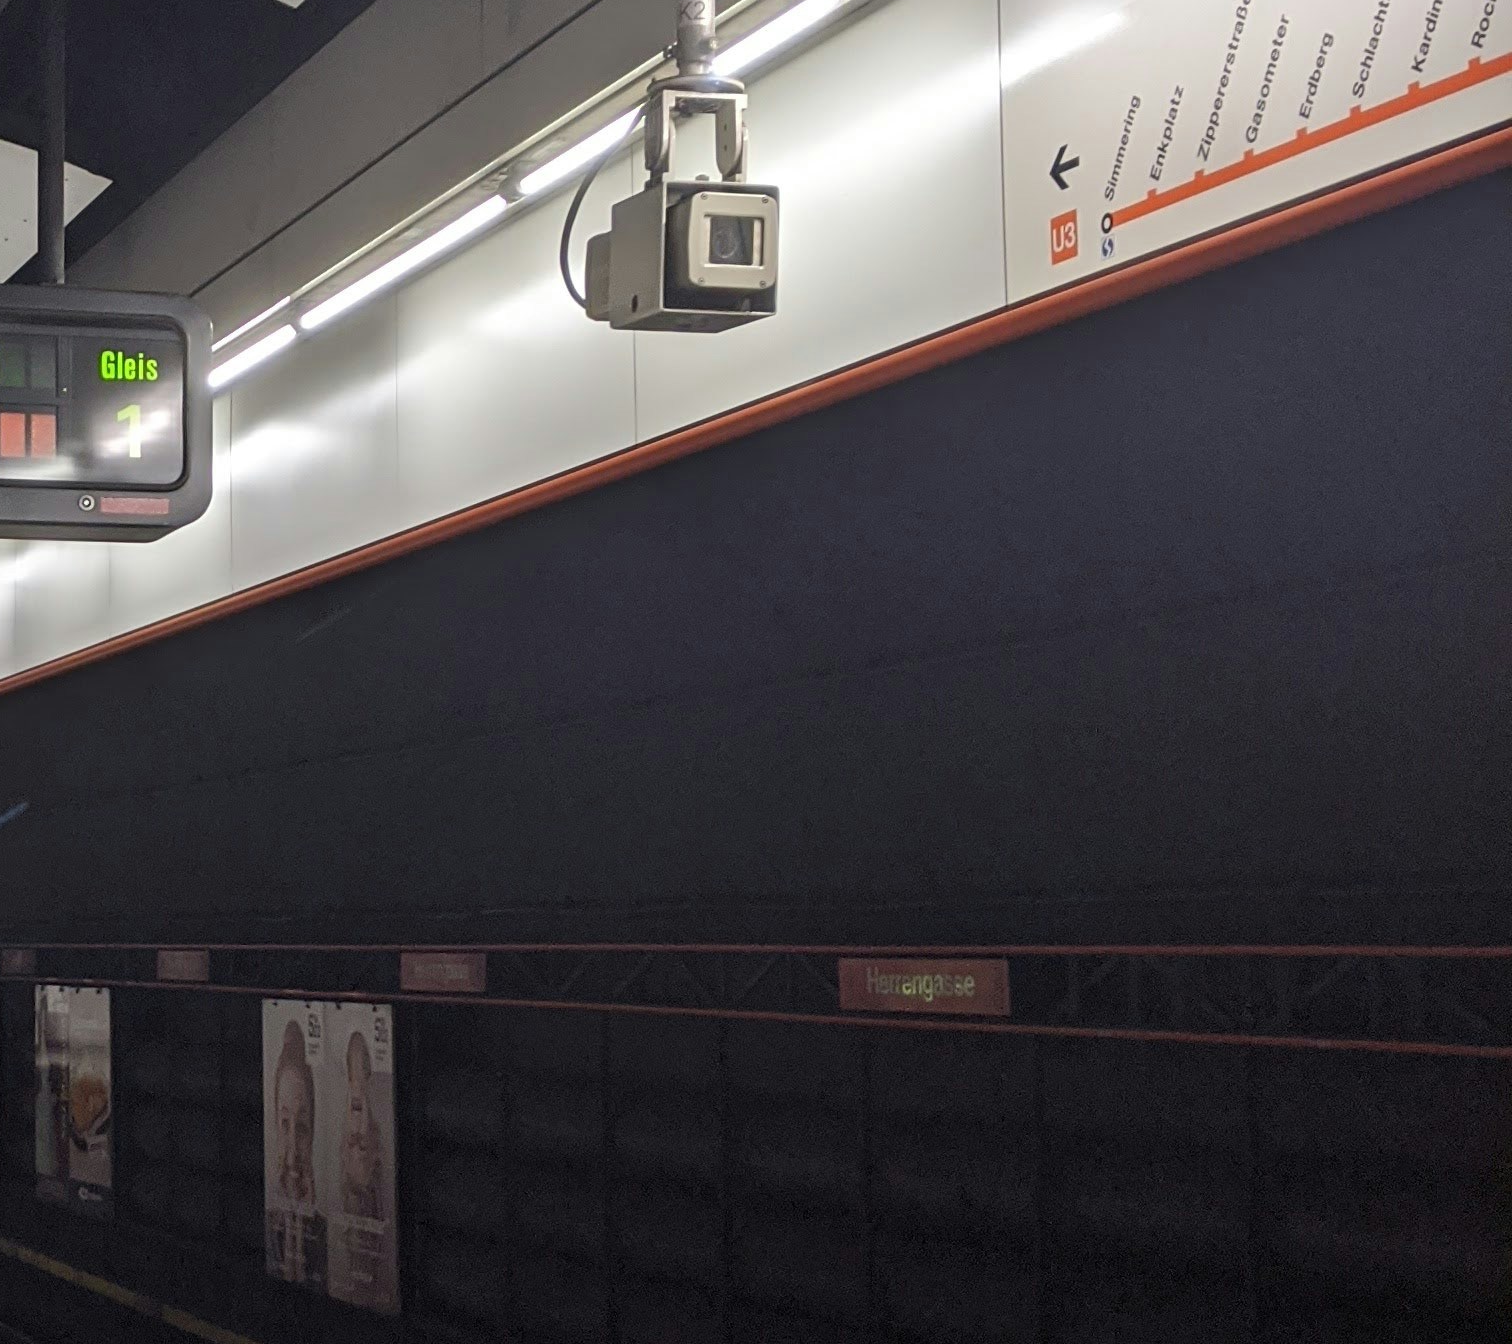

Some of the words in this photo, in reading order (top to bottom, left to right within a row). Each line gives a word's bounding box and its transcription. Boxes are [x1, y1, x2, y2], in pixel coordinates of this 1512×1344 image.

[1245, 13, 1290, 144] Gasometer
[1298, 32, 1335, 120] Erdberg
[1104, 95, 1142, 202] Simmering
[1149, 84, 1185, 182] Enkplatz
[1051, 221, 1078, 253] U3
[99, 350, 159, 382] Gleis
[116, 404, 142, 458] 1
[865, 966, 976, 1003] Herrengasse
